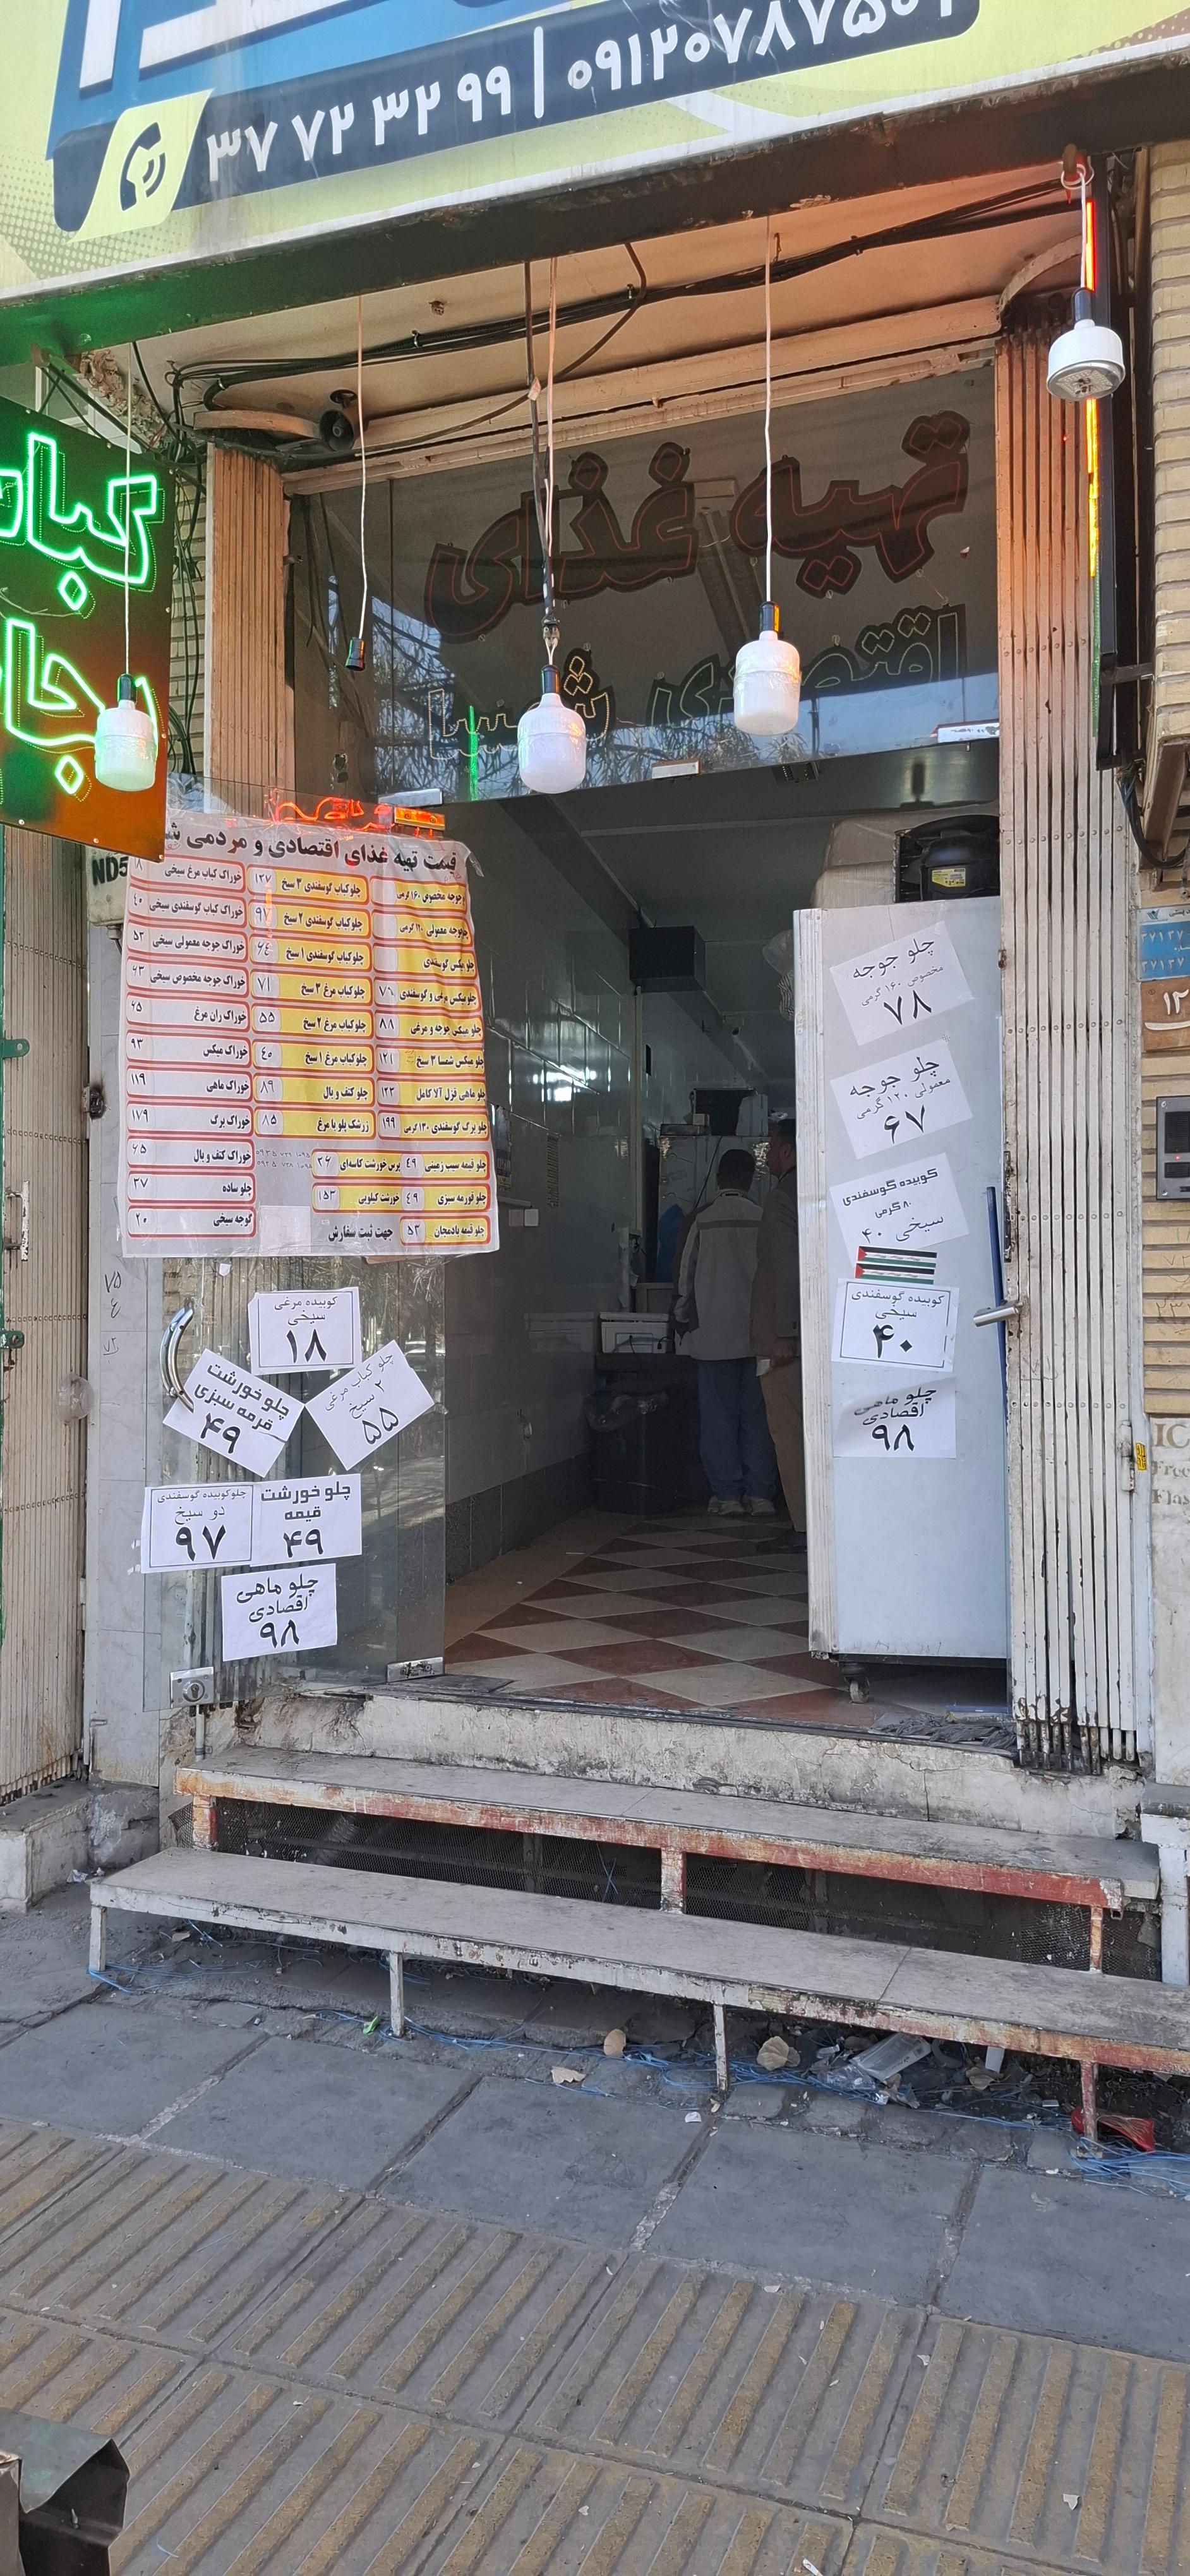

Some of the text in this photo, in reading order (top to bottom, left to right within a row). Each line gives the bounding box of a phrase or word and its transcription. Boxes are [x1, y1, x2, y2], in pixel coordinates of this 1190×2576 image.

[207, 121, 278, 181] ۳۷
[292, 102, 354, 162] ۷۲
[372, 81, 440, 146] ۳۲
[457, 66, 511, 121] ۹۹
[424, 411, 970, 640] تهیه غذای
[186, 831, 248, 854] مردمی
[254, 840, 263, 857] و
[268, 838, 339, 859] اقتصادی
[344, 844, 388, 867] غذای
[394, 850, 418, 872] تهیه
[853, 938, 935, 979] چلو جوجه
[862, 965, 944, 1006] مخصوص ۱۶۰ گرمی
[260, 1011, 275, 1023] ۵۵
[883, 989, 932, 1025] ۷۸
[850, 1056, 939, 1097] چلو جوجه
[857, 1078, 951, 1119] معمولی ۱۲۰ گرمی
[884, 1104, 926, 1144] ۶۷
[843, 1167, 939, 1206] کوبیده گوسفندی
[875, 1201, 901, 1219] گرمی
[862, 1215, 944, 1244] سیخی ۴۰
[274, 1296, 337, 1311] کوبیده مرغی
[851, 1289, 945, 1306] کوبیده گوسفندی
[875, 1302, 917, 1320] سیخی
[288, 1309, 326, 1326] سیخی
[286, 1329, 327, 1363] ۱۸
[873, 1324, 913, 1359] ۴۰
[207, 1364, 290, 1420] چلو خورشت
[325, 1352, 394, 1412] چلو کباب مرغی
[194, 1383, 273, 1431] قرمه سبزی
[349, 1378, 383, 1420] ۲ سیخ
[854, 1386, 937, 1416] چلو ماهی
[200, 1412, 241, 1454] ۴۹
[362, 1407, 399, 1445] ۵۵
[872, 1424, 915, 1452] ۹۸
[157, 1490, 200, 1503] گوسفندی
[261, 1481, 351, 1505] چلو خورشت
[175, 1506, 225, 1525] دو سیخ
[284, 1506, 322, 1521] قیمه
[176, 1525, 226, 1562] ۹۷
[283, 1529, 324, 1558] ۴۹
[237, 1573, 318, 1604] چلو ماهی
[260, 1619, 299, 1649] ۹۸
